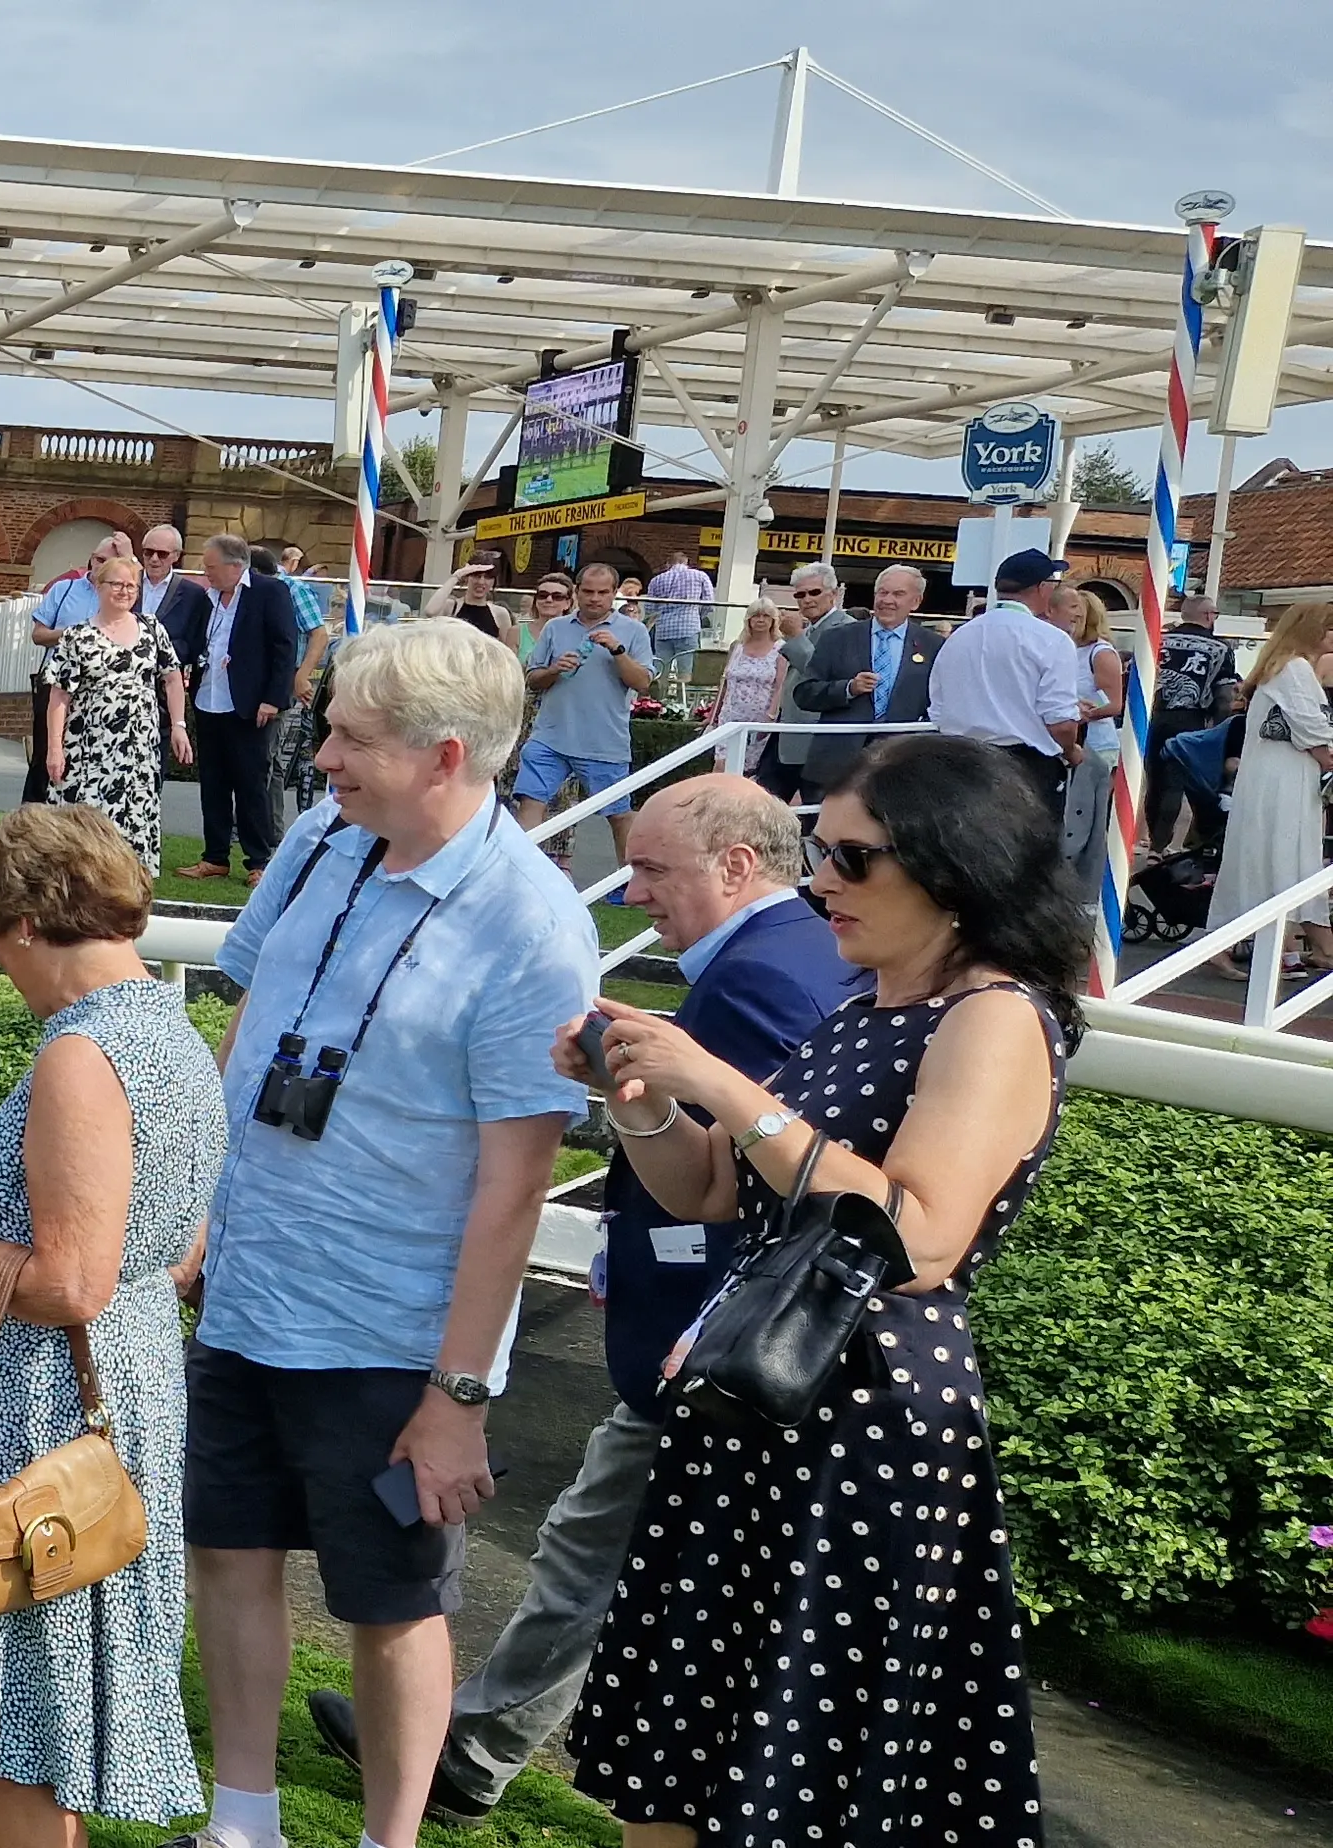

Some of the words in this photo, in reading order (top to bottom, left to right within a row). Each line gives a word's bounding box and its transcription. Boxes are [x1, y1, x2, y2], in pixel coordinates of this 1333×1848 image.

[973, 440, 1042, 466] York
[991, 484, 1017, 494] York
[509, 515, 525, 532] THE
[529, 511, 562, 528] FLYING
[766, 531, 800, 550] THE
[807, 534, 871, 552] FLING
